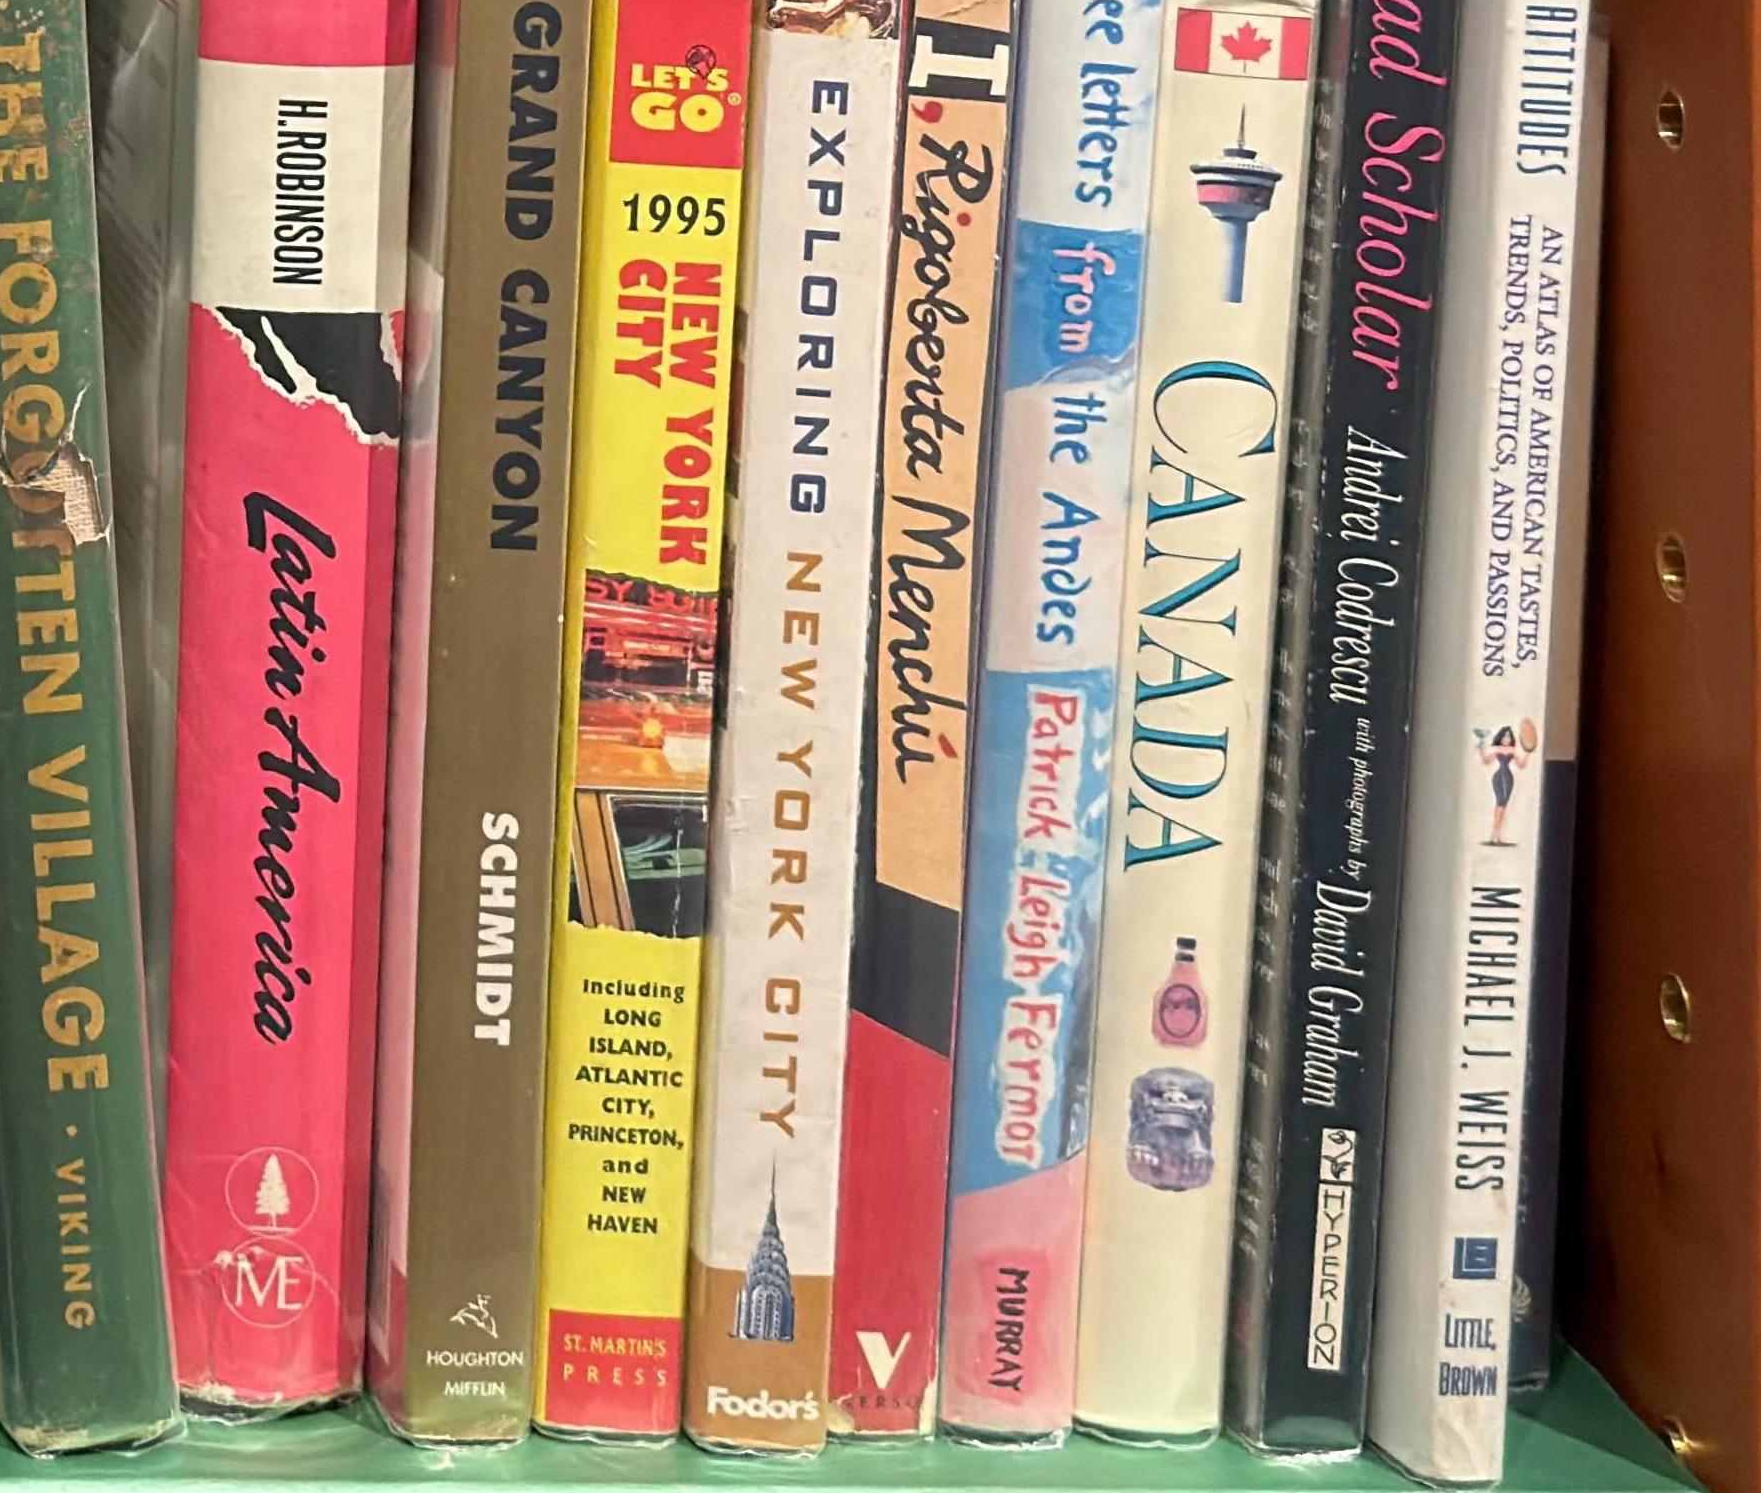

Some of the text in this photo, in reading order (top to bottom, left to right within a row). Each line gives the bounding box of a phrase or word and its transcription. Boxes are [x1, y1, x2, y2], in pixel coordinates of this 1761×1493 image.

[630, 63, 730, 92] LET'S
[1073, 56, 1136, 211] letters
[1515, 3, 1578, 176] ATTITUDES
[272, 98, 328, 288] H.ROBINSON
[621, 195, 726, 237] 1995
[1352, 111, 1448, 393] Scholar
[489, 0, 562, 551] GRAND CANYON
[611, 258, 669, 391] CITY
[1053, 240, 1117, 355] from
[657, 260, 722, 564] NEW YORK
[880, 124, 991, 786] Rigoberta Menchú
[1482, 215, 1531, 679] TRENDS, POLITICS, PASSIONS
[1512, 272, 1561, 669] ATLAS AMERICAN TASTES,
[757, 79, 849, 1140] EXPLORING NEW YORK CITY
[1033, 489, 1101, 649] Andes
[1123, 358, 1277, 872] CANADA
[245, 490, 343, 1044] Latin America
[1301, 424, 1408, 1109] Andrei Codrescu photographs David Graham
[25, 745, 109, 1093] VILLAGE
[473, 810, 520, 1047] SCHMIDT
[998, 692, 1079, 1166] Patrick Leigh Fermor
[581, 978, 686, 1002] Including
[588, 1036, 673, 1061] ISLAND,
[603, 1008, 662, 1029] LONG
[1455, 885, 1522, 1194] MICHAEL WEISS
[568, 1124, 683, 1150] PRINCETON,
[575, 1066, 683, 1089] ATLANTIC
[601, 1097, 654, 1119] CITY,
[586, 1213, 659, 1235] HAVEN
[602, 1156, 648, 1175] and
[602, 1185, 647, 1204] NEW
[51, 1160, 95, 1329] VIKING
[1311, 1188, 1347, 1367] HYPERION
[426, 1349, 526, 1367] HOUGHTON
[444, 1380, 506, 1397] MIFFLIN
[562, 1364, 668, 1386] PRESS
[589, 1334, 668, 1359] MARTIN'S
[987, 1265, 1029, 1394] MURRAY
[1438, 1361, 1497, 1398] BROWN
[1443, 1312, 1497, 1351] LITTLE,
[706, 1385, 819, 1421] Fodor's
